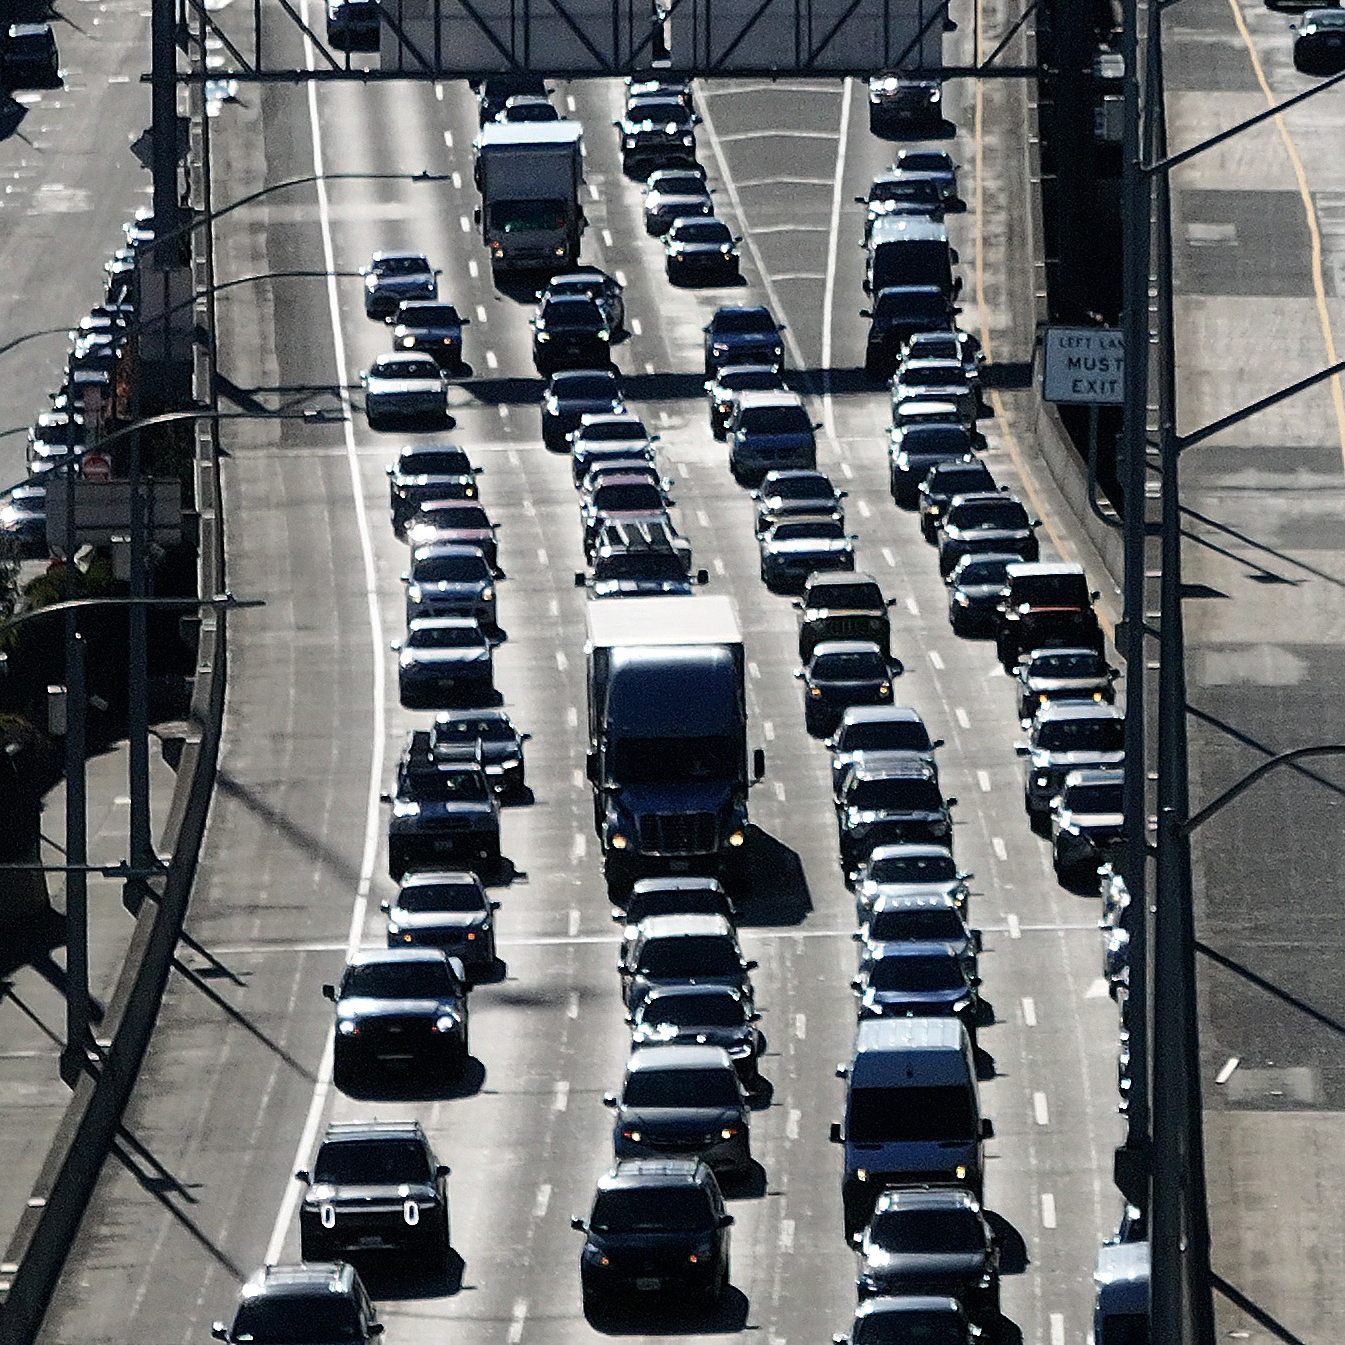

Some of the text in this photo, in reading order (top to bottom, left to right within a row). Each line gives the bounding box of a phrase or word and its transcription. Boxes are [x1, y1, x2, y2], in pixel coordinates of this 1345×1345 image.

[1059, 336, 1092, 349] LEFT
[1067, 356, 1124, 372] MUST
[1071, 379, 1118, 395] EXIT
